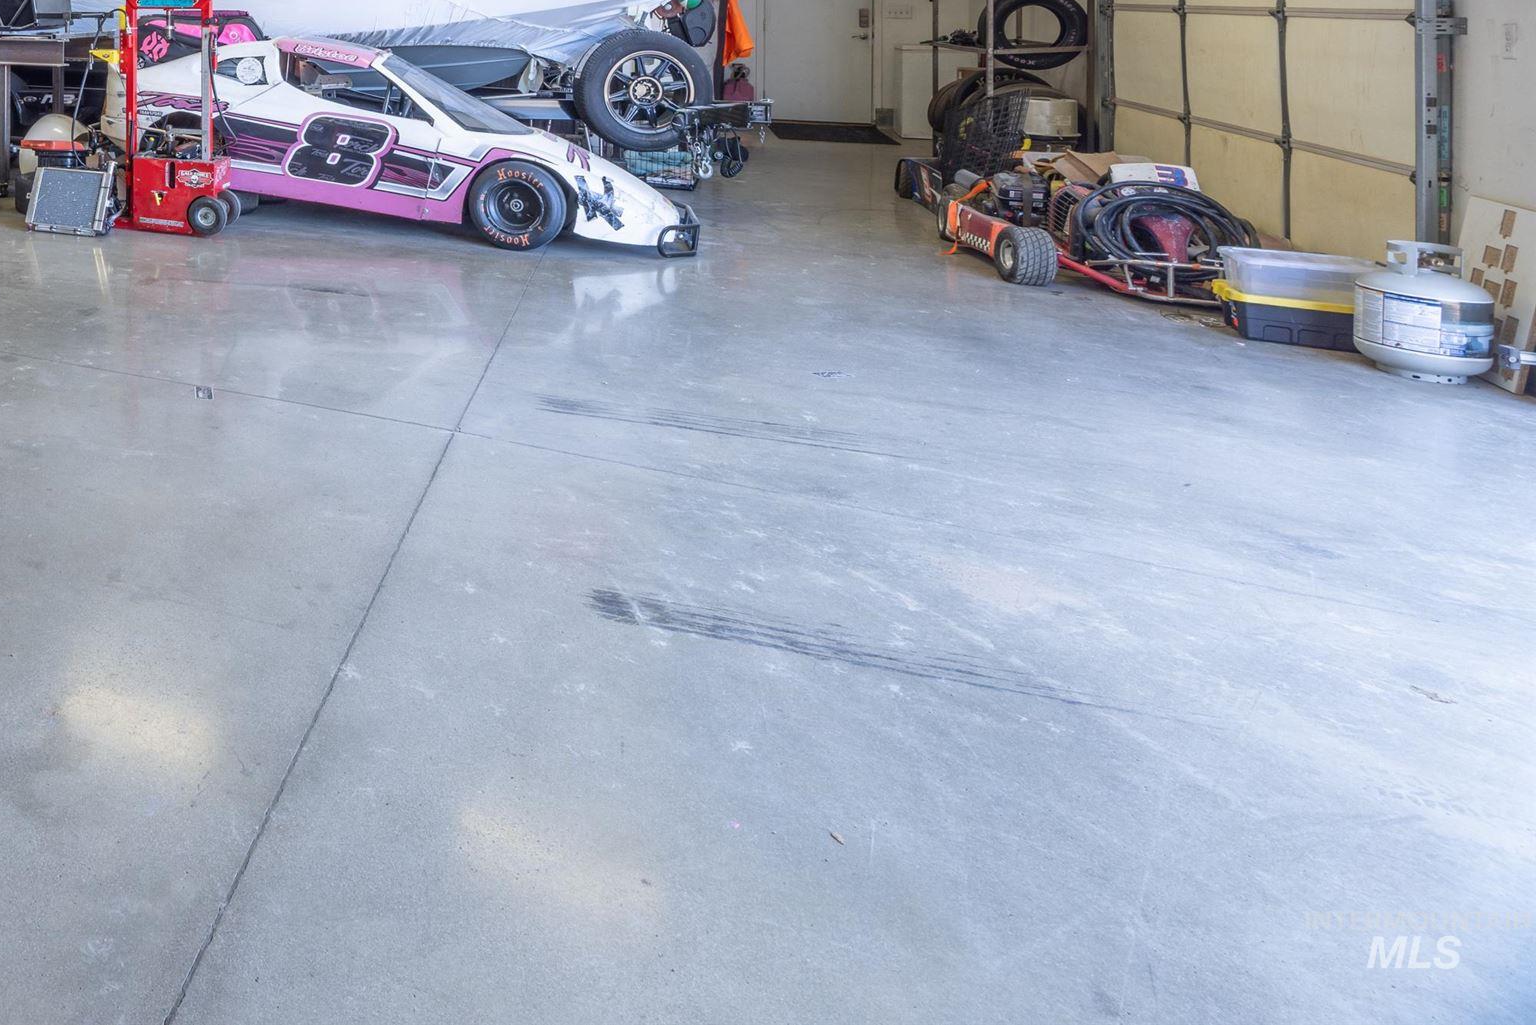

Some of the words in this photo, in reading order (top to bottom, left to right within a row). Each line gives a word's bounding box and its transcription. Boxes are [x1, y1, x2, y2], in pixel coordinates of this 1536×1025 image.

[282, 112, 400, 189] 8
[497, 166, 544, 189] Hoosier
[482, 224, 530, 247] Hoosier
